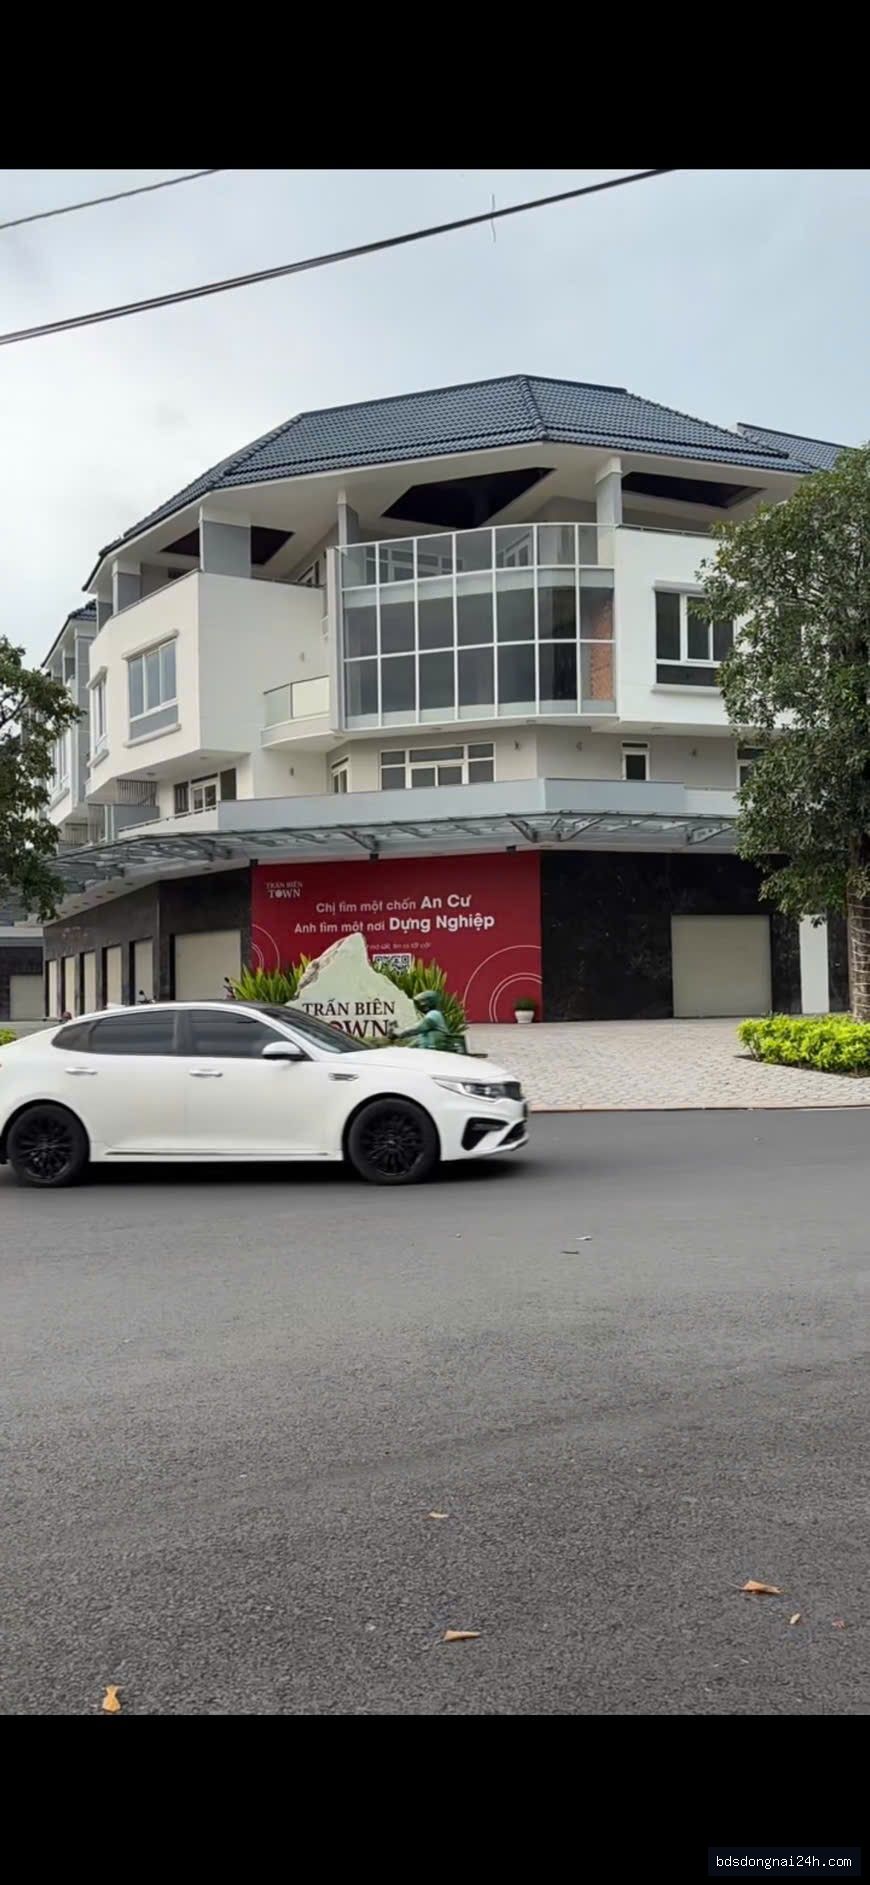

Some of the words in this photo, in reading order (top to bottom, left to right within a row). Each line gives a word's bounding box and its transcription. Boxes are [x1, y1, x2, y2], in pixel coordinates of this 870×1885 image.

[316, 902, 336, 915] Chị
[339, 900, 357, 912] tìm
[360, 900, 382, 914] một
[386, 898, 416, 911] chốn
[420, 896, 442, 909] An
[447, 894, 472, 907] Cư
[294, 923, 317, 933] Anh
[320, 921, 338, 933] tìm
[367, 921, 385, 931] nơi
[389, 917, 431, 933] Dựng
[436, 913, 495, 931] Nghiệp
[355, 998, 395, 1015] BIÊN
[329, 1020, 389, 1038] WN
